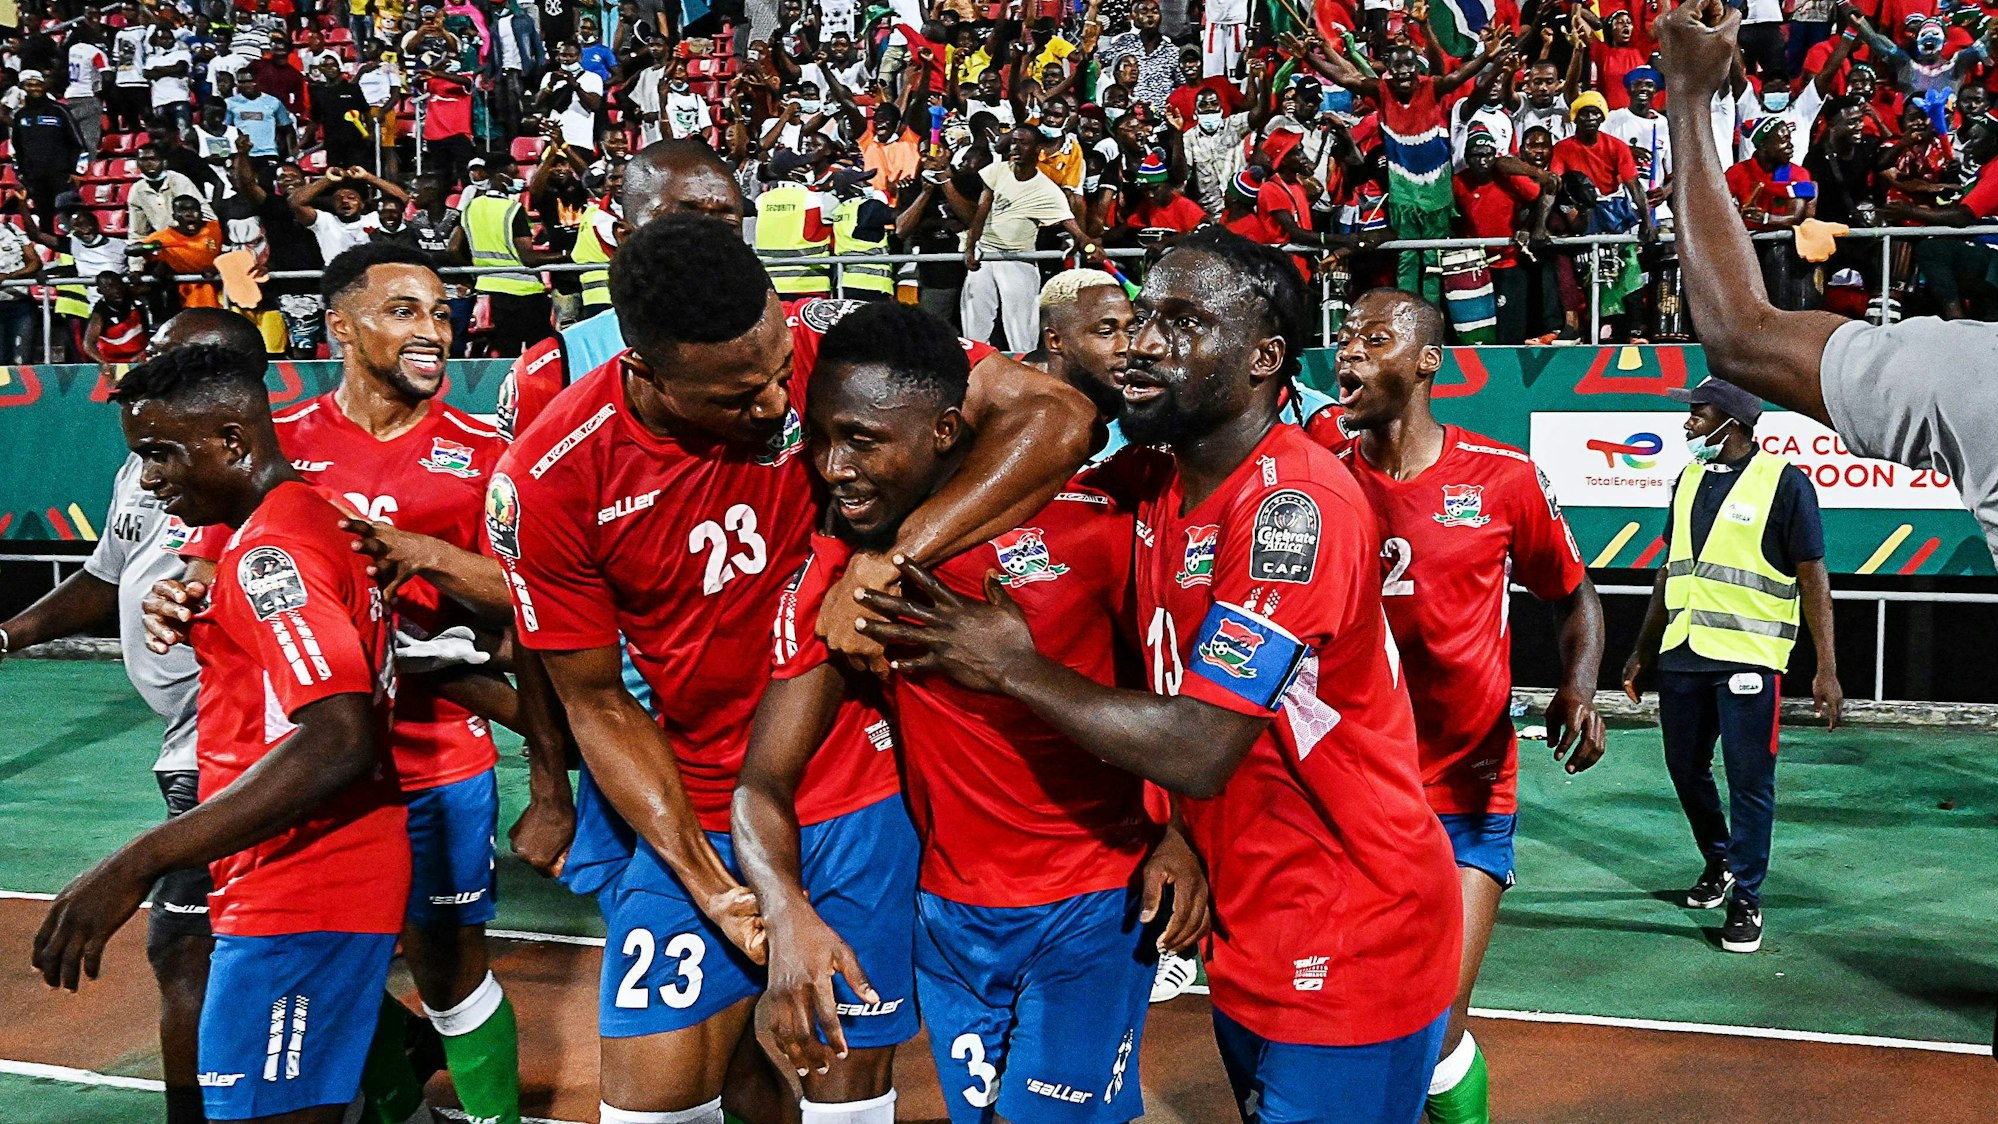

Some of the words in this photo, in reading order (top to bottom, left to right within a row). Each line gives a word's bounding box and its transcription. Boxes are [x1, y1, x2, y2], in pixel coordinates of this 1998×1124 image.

[766, 203, 796, 212] SECURITY
[1812, 435, 1849, 455] CU
[1585, 476, 1663, 489] TotalEnergies
[1257, 525, 1317, 545] Celebrate
[689, 503, 767, 597] 23
[1264, 540, 1304, 553] Africa
[1262, 561, 1302, 575] CAF
[615, 927, 706, 1009] 23
[951, 1032, 1000, 1108] 3
